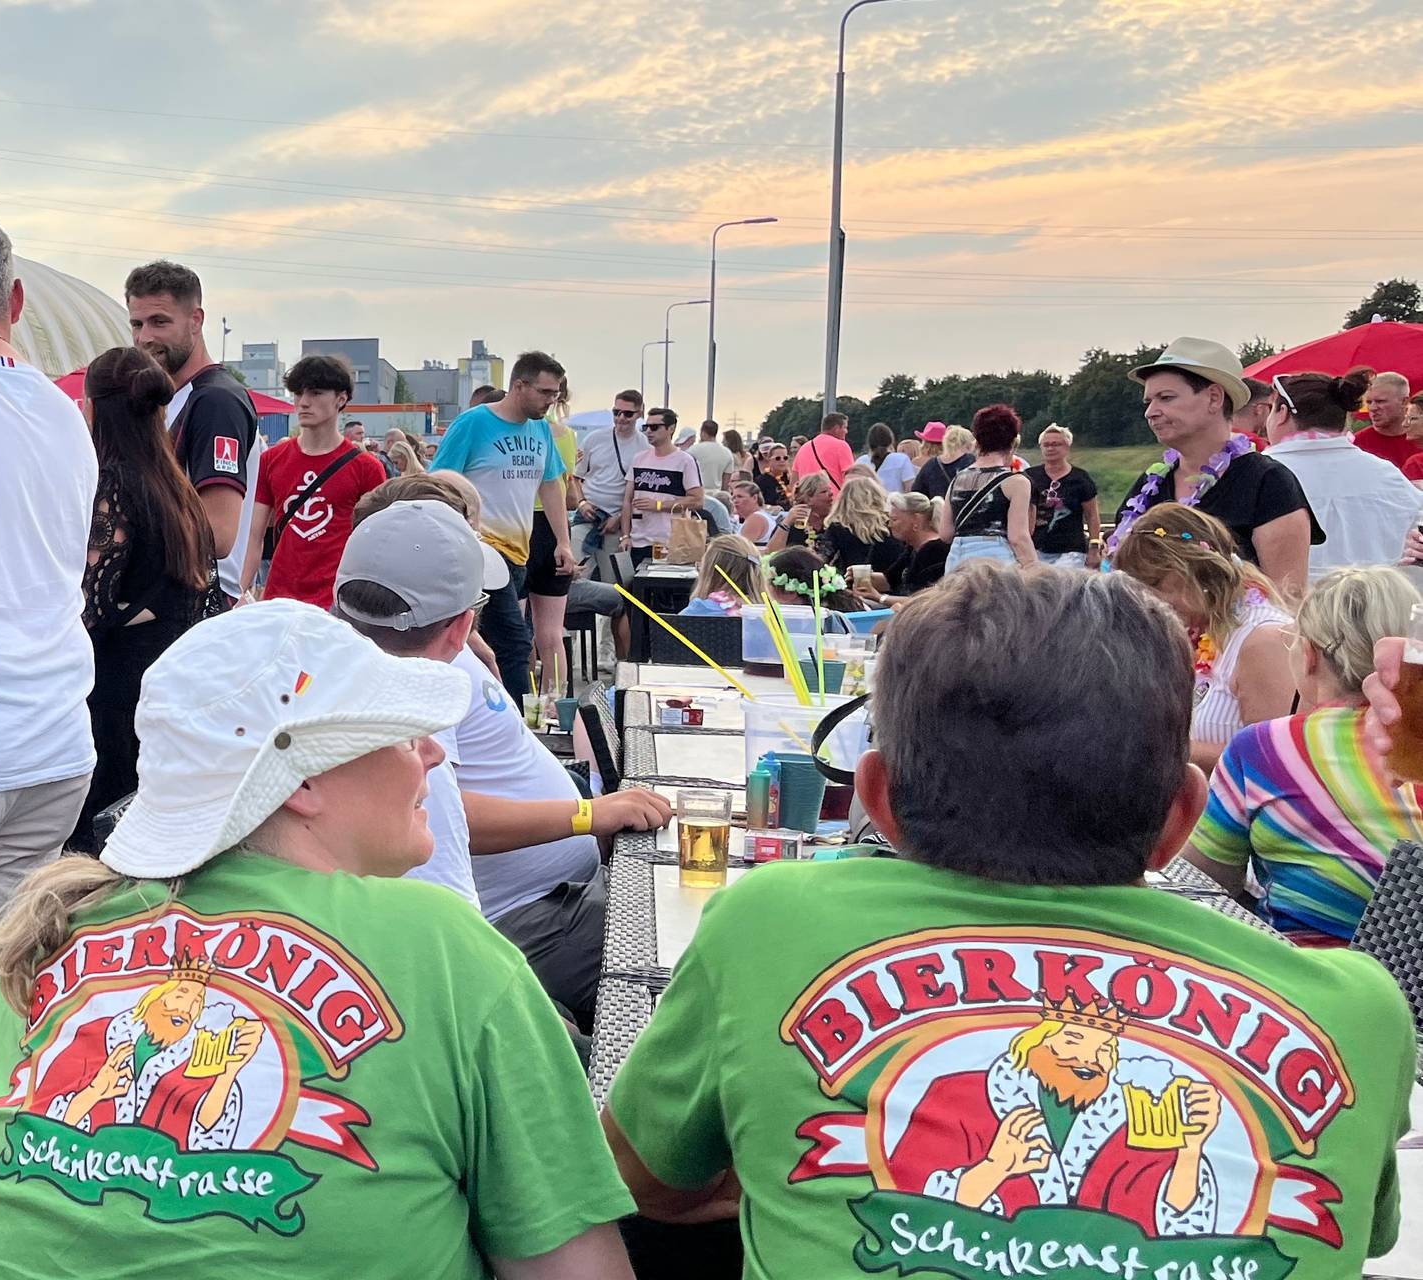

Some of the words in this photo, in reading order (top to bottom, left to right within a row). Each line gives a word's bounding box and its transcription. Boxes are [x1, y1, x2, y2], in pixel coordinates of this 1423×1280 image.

[493, 435, 543, 456] VENICE
[512, 455, 535, 467] BEACH
[502, 469, 515, 479] LOS
[32, 918, 379, 1046] BIERKÖNIG
[806, 948, 1334, 1112] BIERKÖNIG
[18, 1128, 276, 1198] Schinkenstrasse
